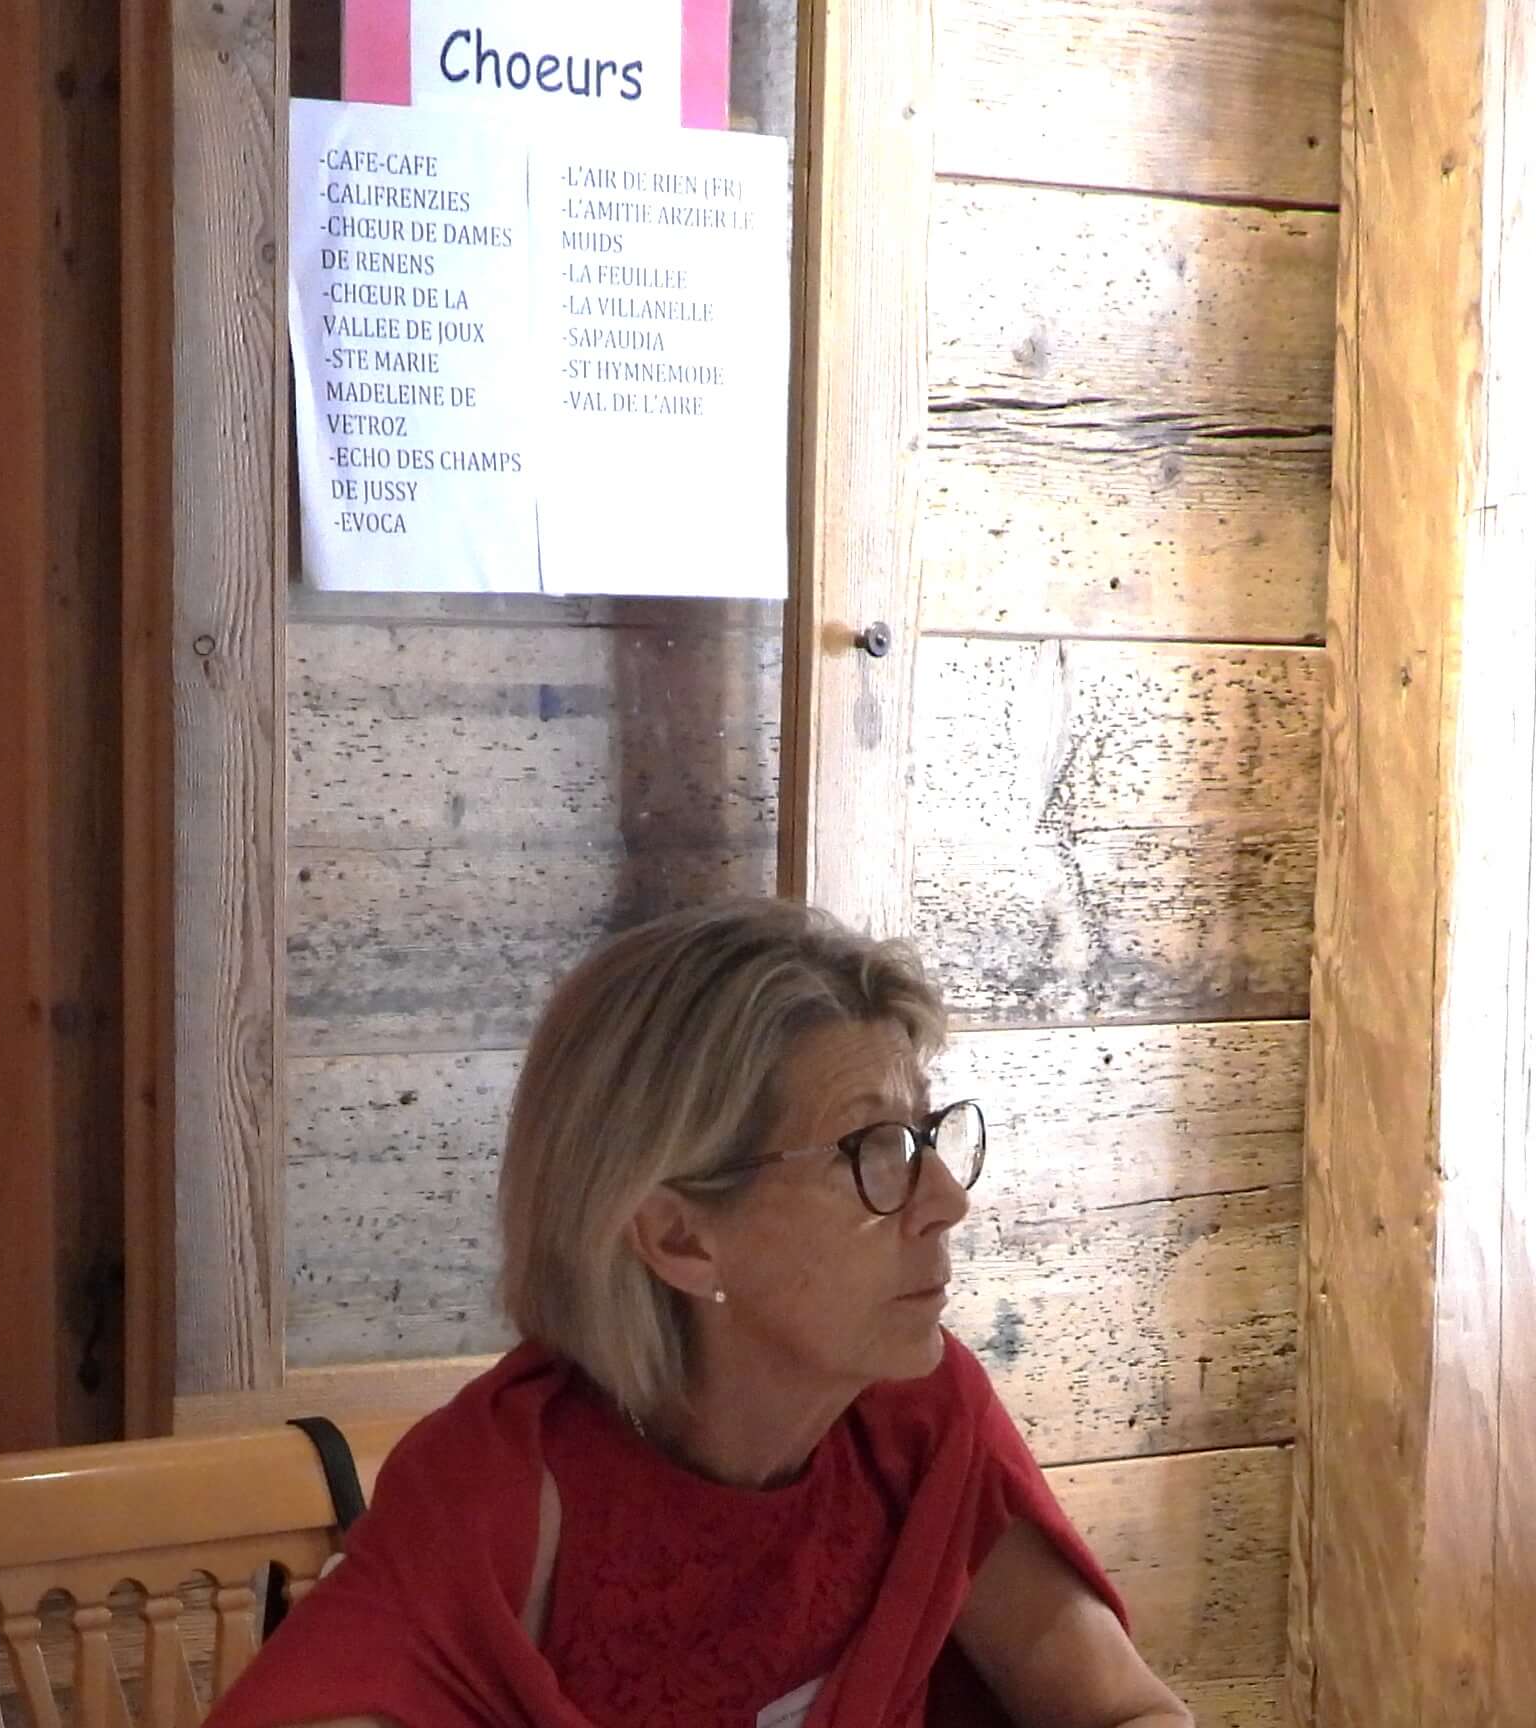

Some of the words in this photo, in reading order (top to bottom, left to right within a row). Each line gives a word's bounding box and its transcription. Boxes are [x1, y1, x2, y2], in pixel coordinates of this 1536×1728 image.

[439, 28, 643, 100] Choeurs
[319, 149, 438, 177] -CAFE-CAFE
[561, 166, 617, 189] -L'AIR
[623, 170, 647, 192] DE
[653, 173, 697, 195] RIEN
[704, 176, 744, 201] (FR)
[320, 182, 470, 212] -CALIFRENZIES
[561, 198, 653, 224] -L'AMITIE
[658, 206, 727, 228] ARZIER
[733, 209, 756, 231] LE
[411, 220, 438, 243] DE
[443, 222, 513, 247] DAMES
[562, 230, 623, 253] MUIDS
[321, 249, 349, 270] DE
[356, 250, 435, 275] RENENS
[562, 263, 592, 284] -LA
[598, 264, 688, 289] FEUILLEE
[412, 287, 439, 308] DE
[444, 289, 469, 310] LA
[562, 295, 592, 316] -LA
[598, 297, 715, 322] VILLANELLE
[323, 315, 401, 339] VALLEE
[406, 319, 432, 341] DE
[438, 321, 485, 345] JOUX
[562, 327, 664, 352] -SAPAUDIA
[325, 348, 369, 370] -STE
[375, 351, 439, 373] MARIE
[561, 359, 592, 379] -ST
[597, 360, 725, 385] HYMNEMODE
[326, 381, 445, 406] MADELEINE
[451, 386, 477, 408] DE
[563, 390, 607, 412] -VAL
[613, 392, 638, 413] DE
[644, 394, 703, 416] L'AIRE
[328, 414, 408, 437] VETROZ
[329, 447, 390, 468] -ECHO
[397, 450, 434, 470] DES
[440, 450, 522, 473] CHAMPS
[331, 479, 359, 500] DE
[363, 480, 418, 504] JUSSY
[334, 512, 407, 534] -EVOCA
